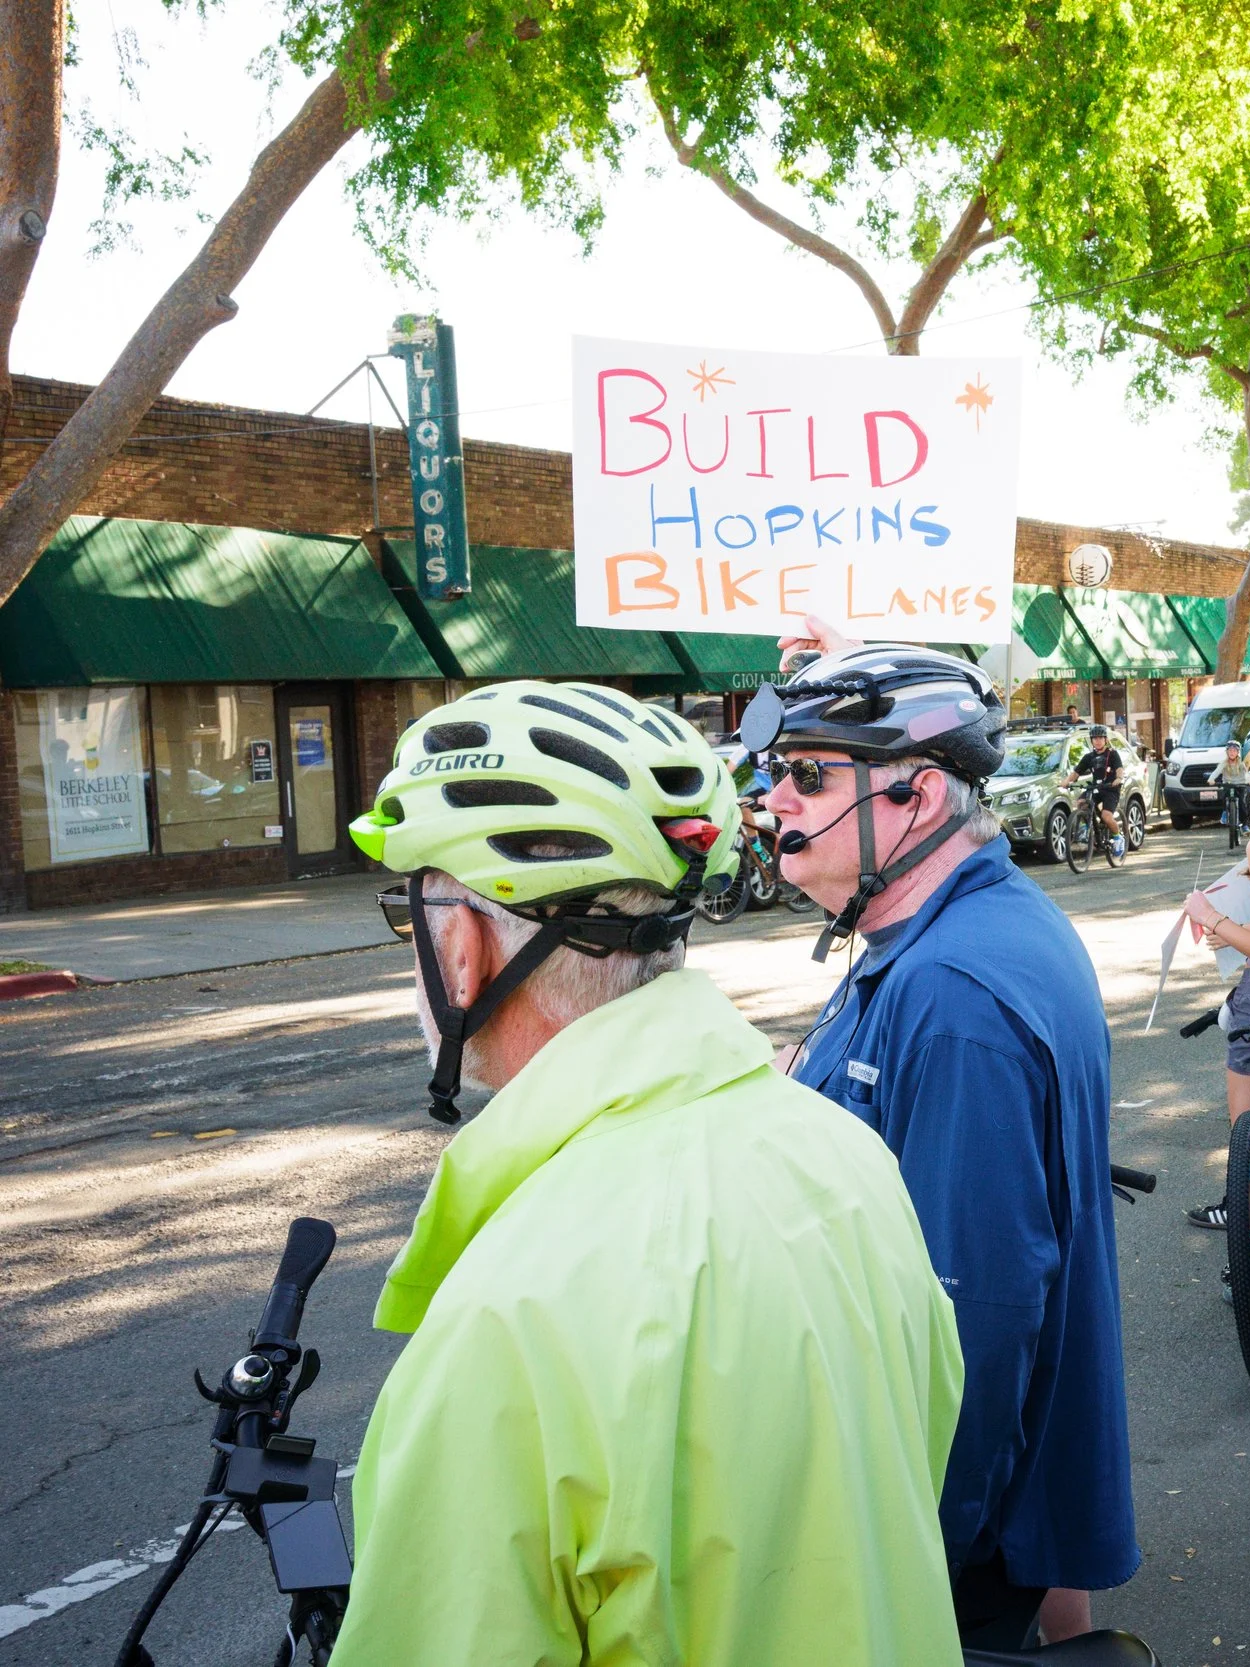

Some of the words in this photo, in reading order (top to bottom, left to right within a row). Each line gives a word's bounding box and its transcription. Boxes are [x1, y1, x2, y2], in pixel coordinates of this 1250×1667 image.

[598, 368, 929, 488] BUILD
[413, 352, 448, 583] LIQUORS
[650, 483, 951, 549] HOPKINS
[605, 550, 818, 617] BIKE
[847, 563, 997, 622] LANES
[732, 673, 765, 688] GIOIA
[434, 753, 504, 772] GIRO
[60, 775, 129, 797] BERKELEY
[61, 794, 92, 809] LITTLE
[94, 791, 132, 806] SCHOOL
[82, 823, 110, 835] Hopkins
[111, 821, 131, 831] Street
